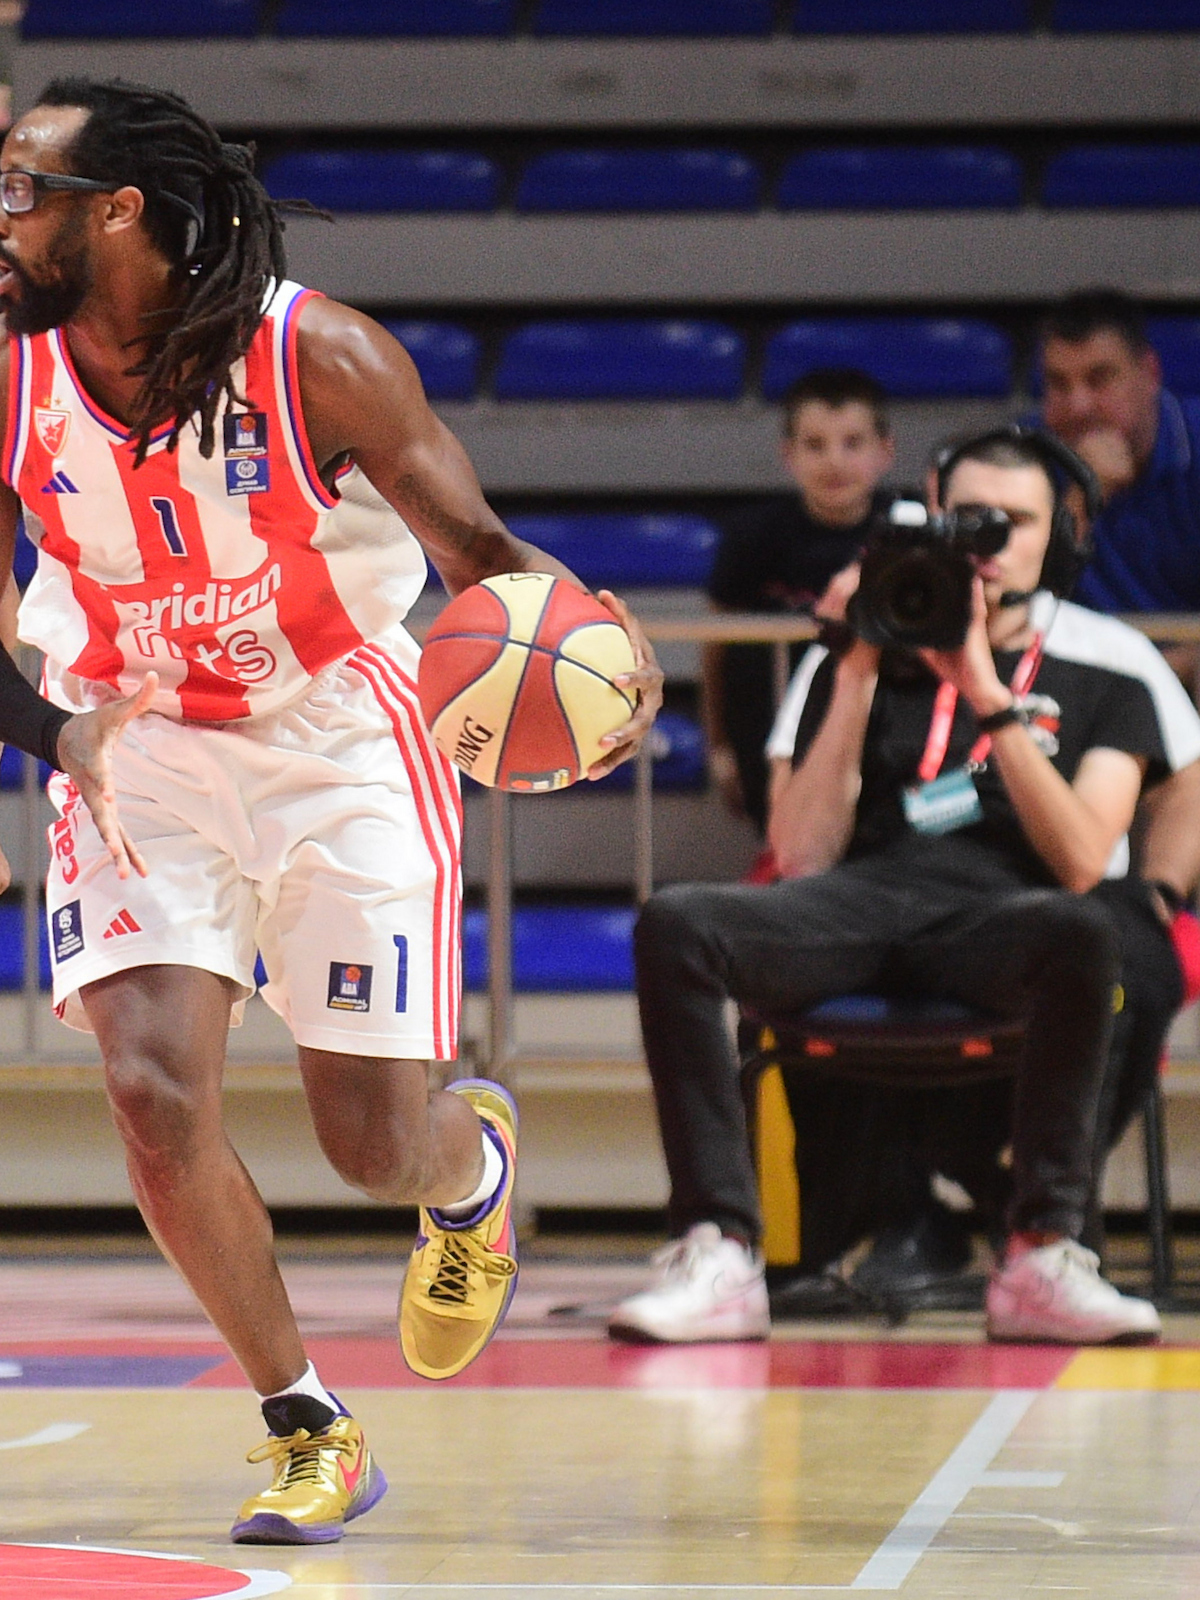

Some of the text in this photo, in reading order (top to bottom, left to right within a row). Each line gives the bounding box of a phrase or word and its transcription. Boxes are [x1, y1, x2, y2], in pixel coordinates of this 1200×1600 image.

[150, 496, 188, 557] 1
[124, 562, 282, 630] eridian
[393, 934, 408, 1013] 1
